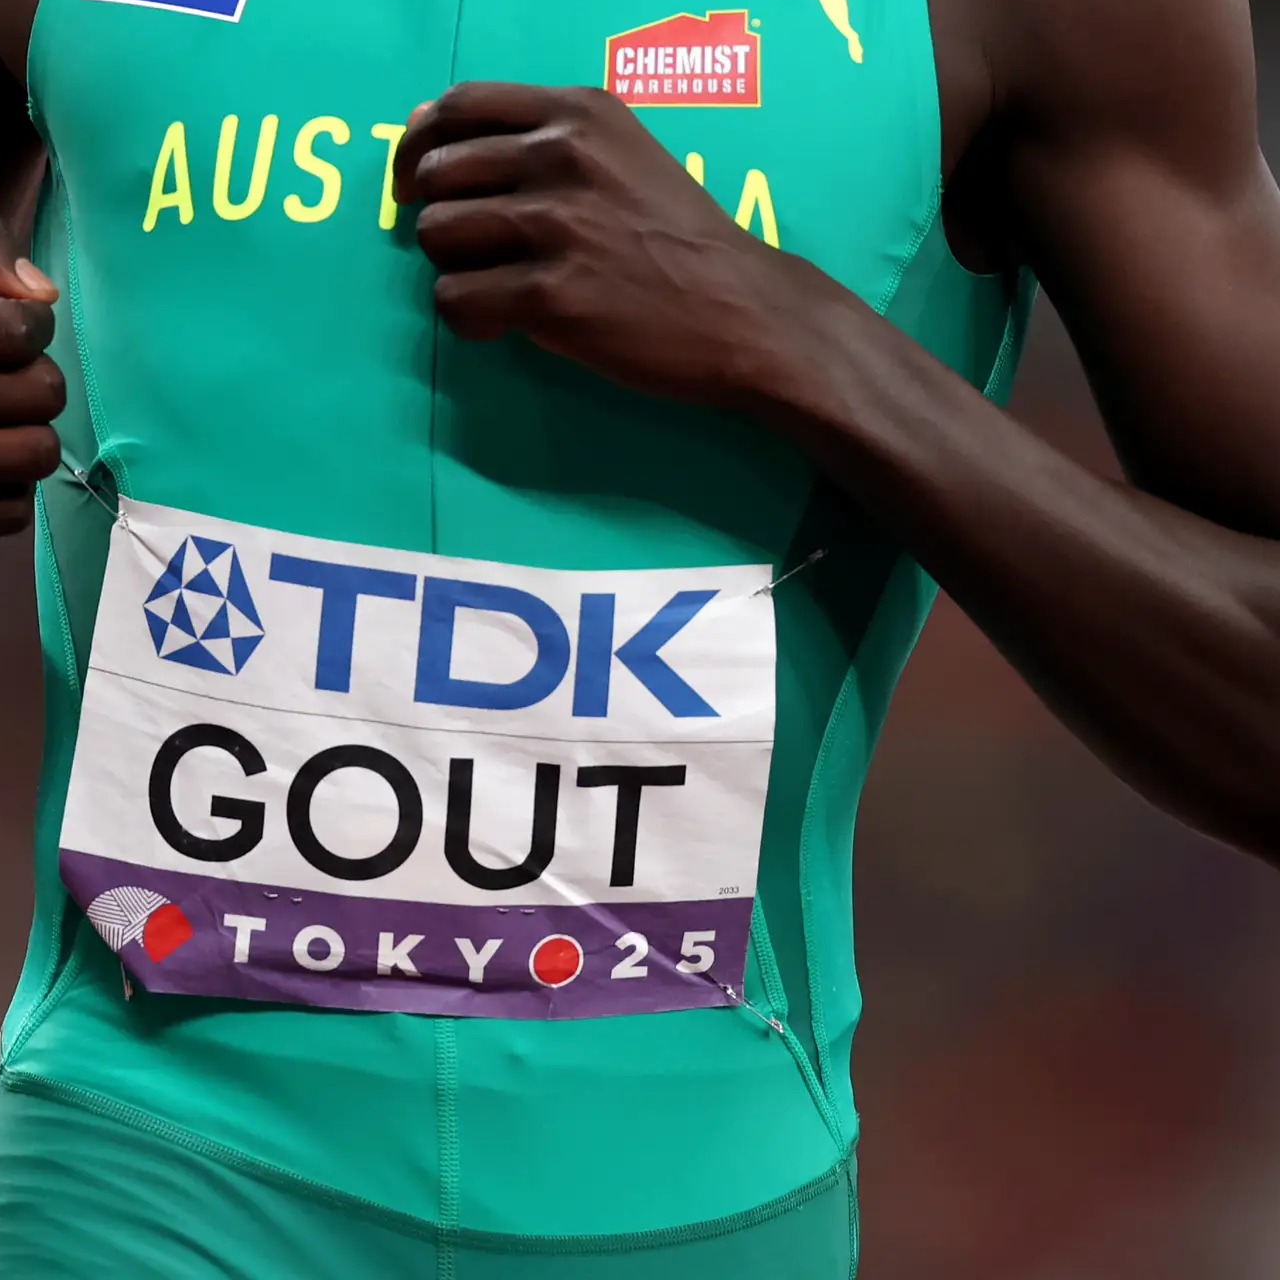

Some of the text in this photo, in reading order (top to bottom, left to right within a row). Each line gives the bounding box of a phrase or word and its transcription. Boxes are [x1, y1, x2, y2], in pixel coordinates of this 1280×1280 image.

[615, 45, 750, 76] CHEMIST
[615, 78, 746, 94] WAREHOUSE
[142, 114, 780, 250] AUSTA
[269, 552, 721, 718] TDK
[148, 723, 686, 890] GOUT
